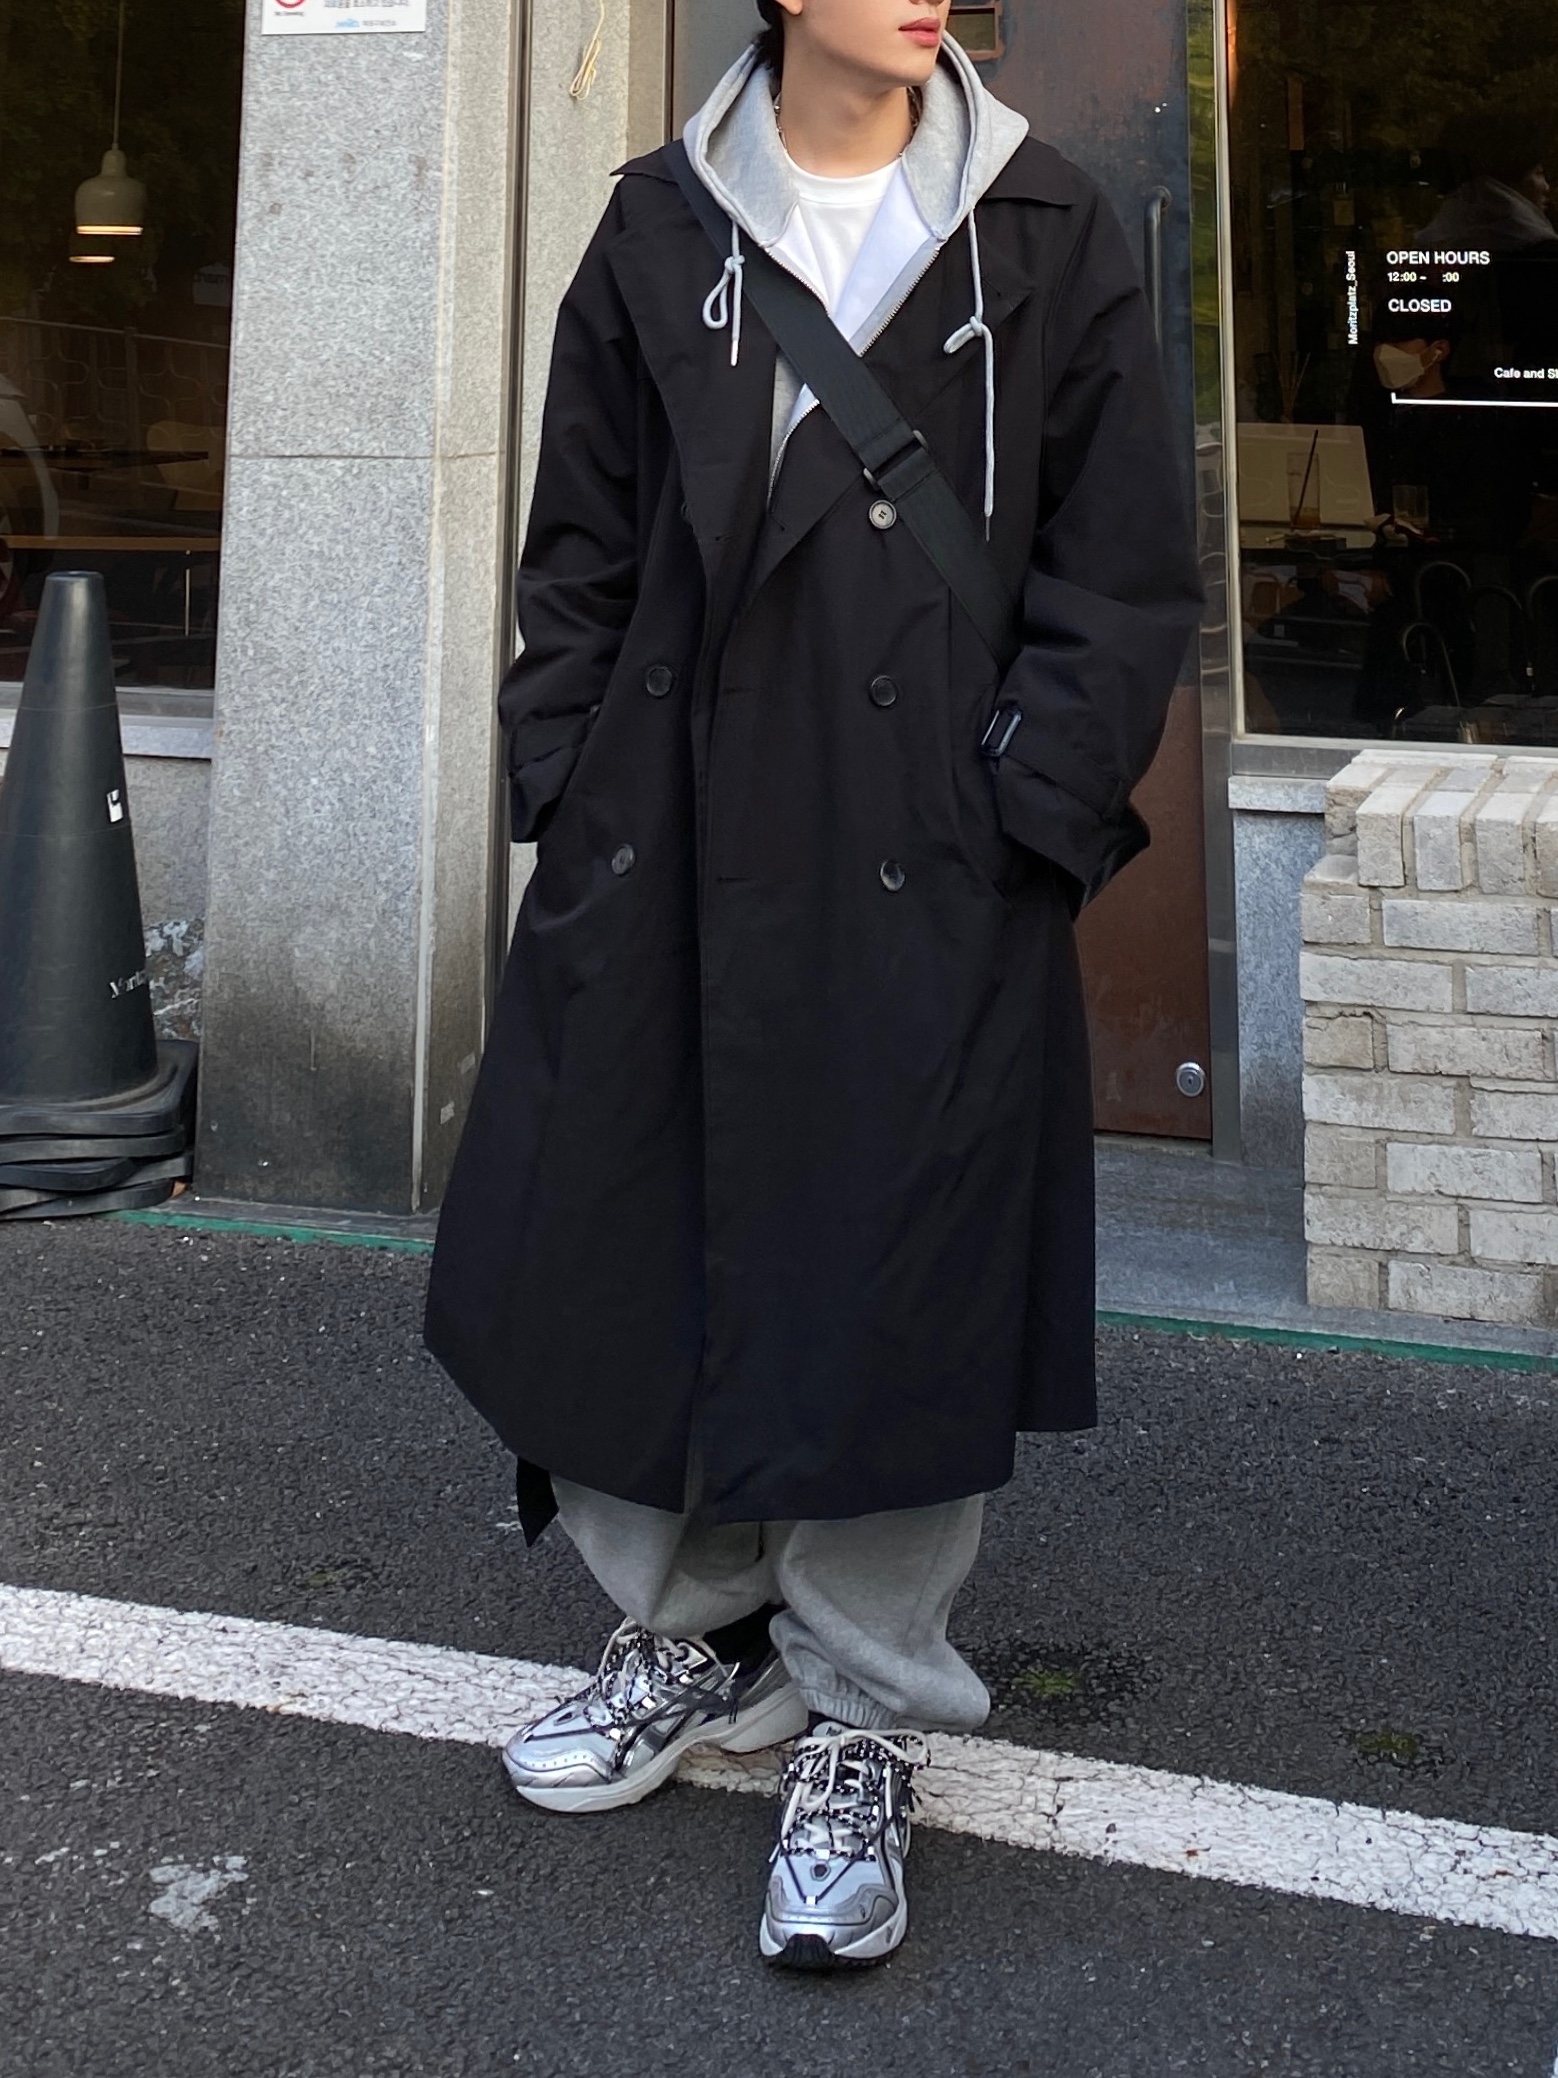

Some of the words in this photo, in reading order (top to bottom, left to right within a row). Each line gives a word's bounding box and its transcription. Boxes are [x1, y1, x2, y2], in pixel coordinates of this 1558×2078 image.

[1386, 250, 1430, 265] OPEN
[1434, 250, 1490, 265] HOURS
[1387, 271, 1417, 282] 12:00
[1388, 298, 1452, 313] CLOSED
[1493, 366, 1521, 379] Cafe
[1523, 367, 1545, 379] and
